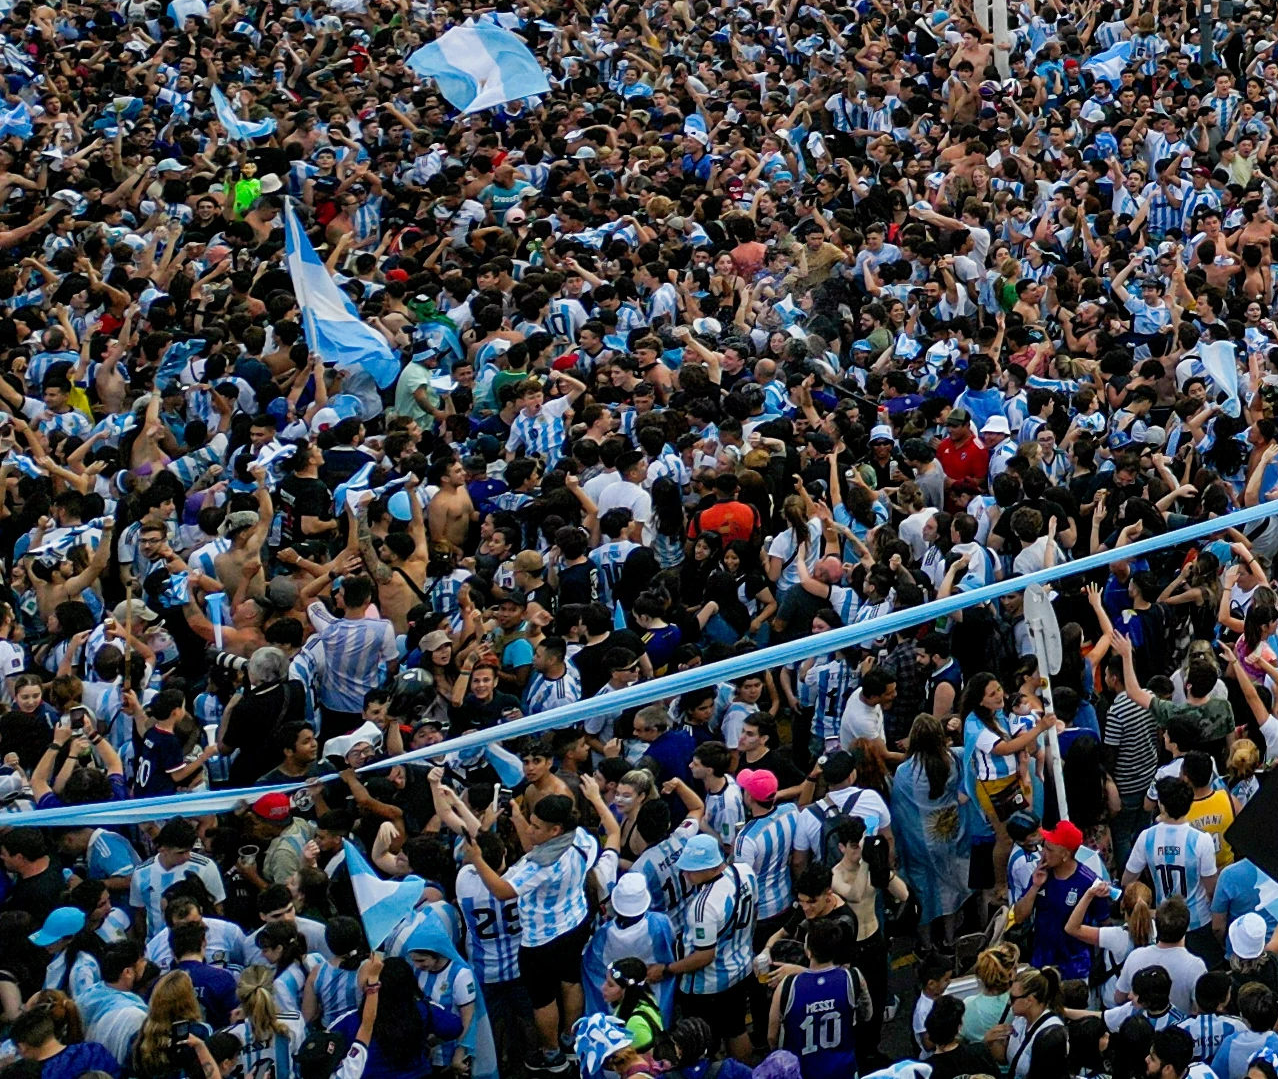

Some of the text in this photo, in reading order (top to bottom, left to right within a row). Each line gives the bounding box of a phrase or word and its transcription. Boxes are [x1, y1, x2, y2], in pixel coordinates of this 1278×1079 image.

[1157, 846, 1181, 856] MESSI
[1155, 864, 1187, 899] 10
[805, 998, 837, 1014] MESSI
[799, 1011, 843, 1056] 10
